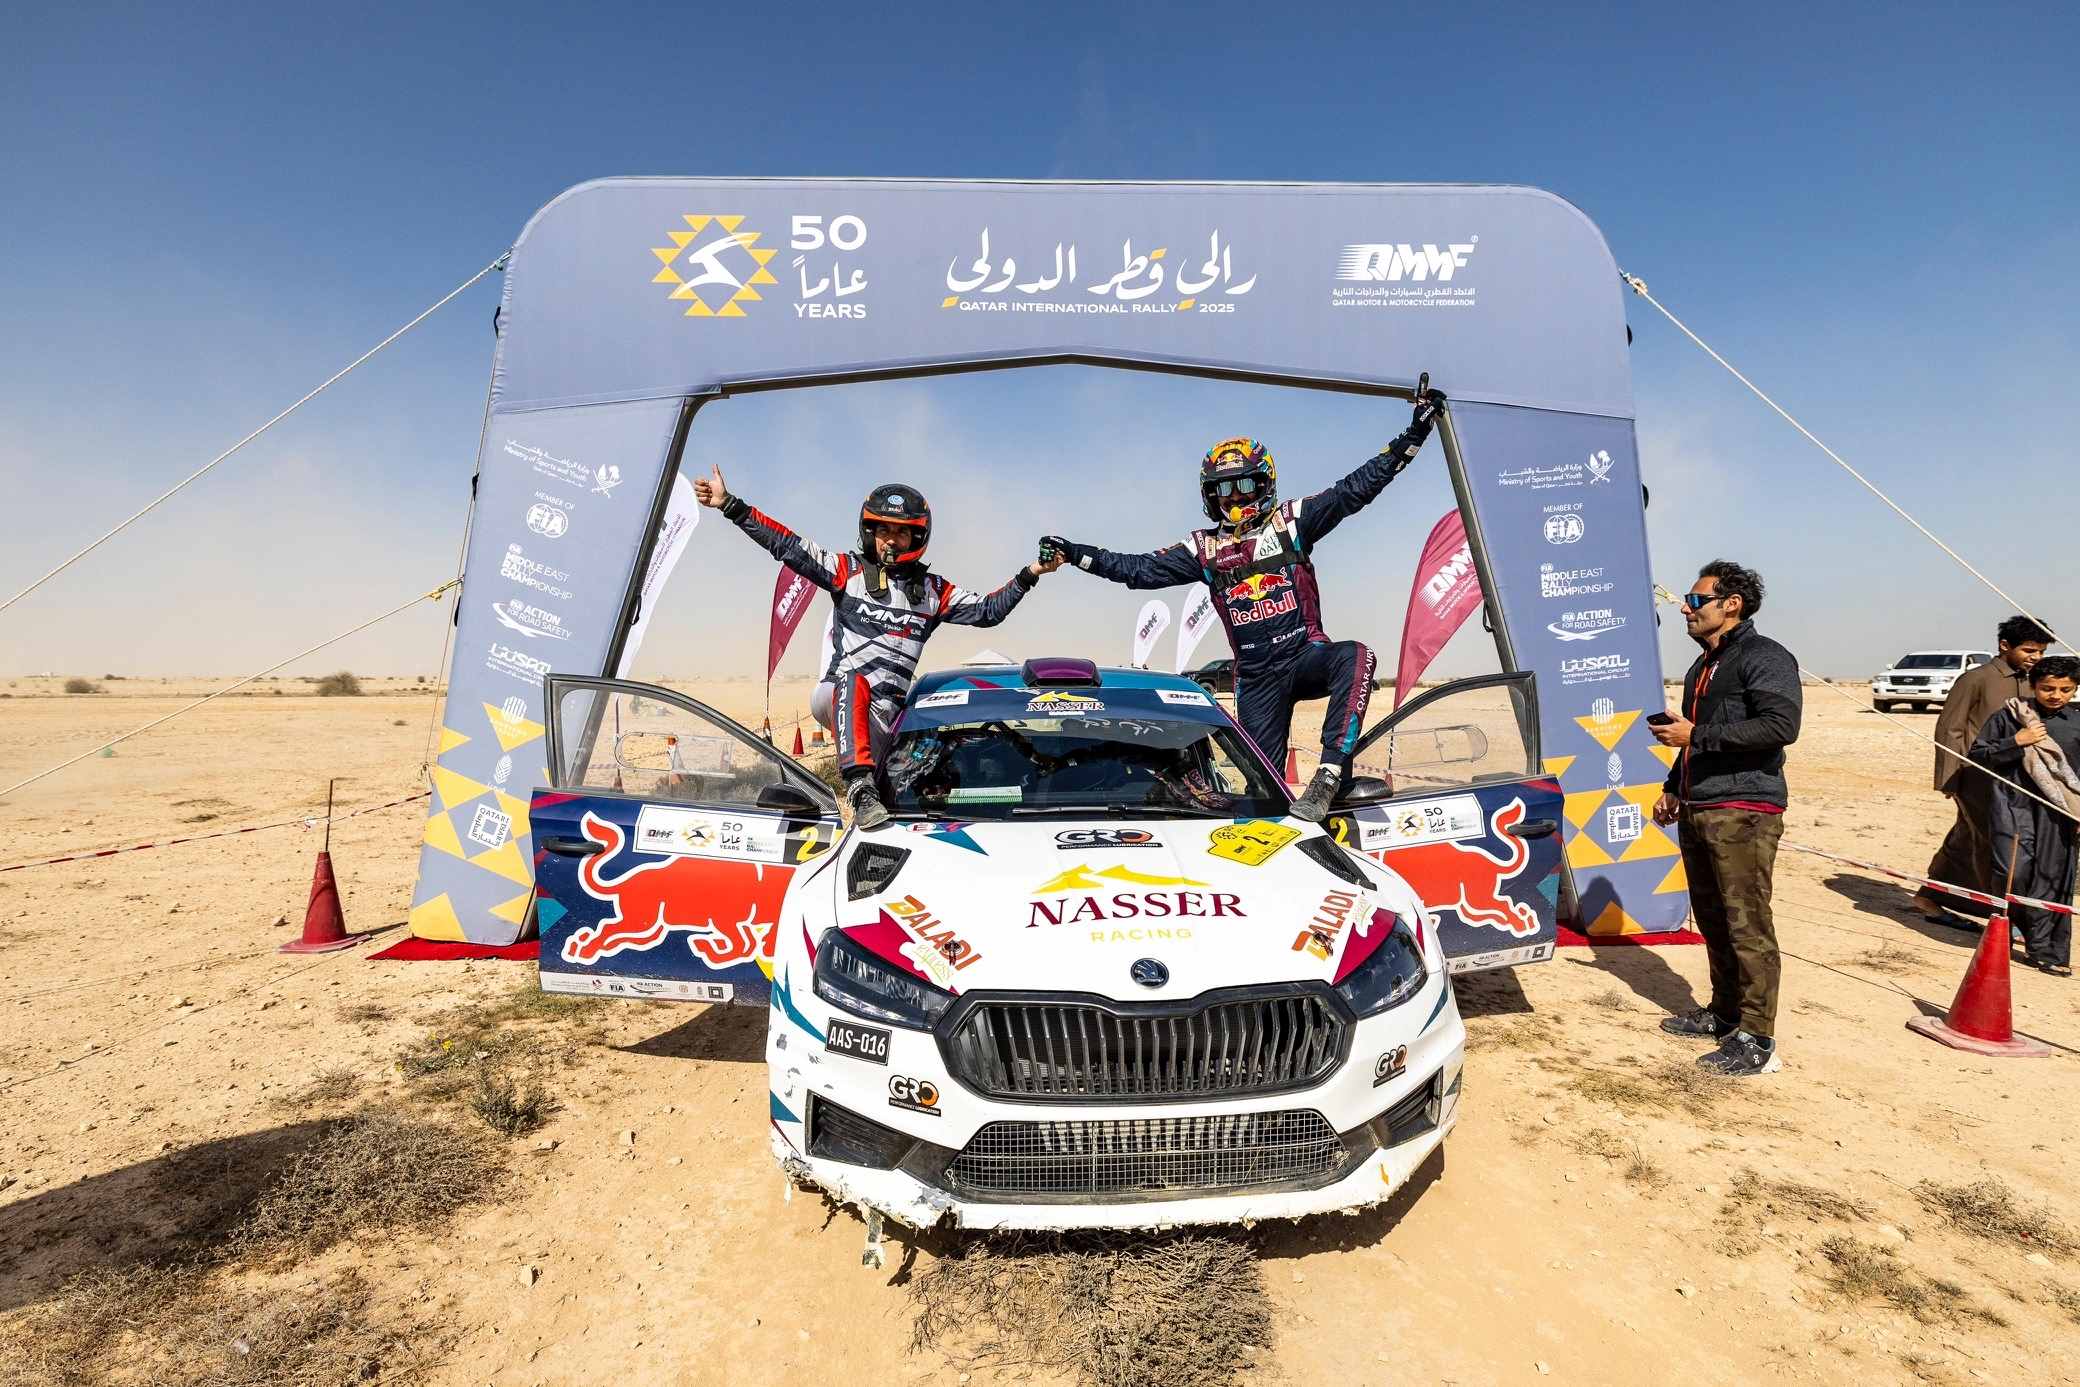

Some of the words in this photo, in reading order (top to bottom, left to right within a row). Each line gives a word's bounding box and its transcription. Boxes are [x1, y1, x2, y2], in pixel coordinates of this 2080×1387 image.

[790, 214, 868, 250] 50
[946, 225, 1077, 293] الدولي
[1087, 238, 1168, 300] قطر
[1176, 228, 1257, 294] رالي
[1333, 243, 1475, 281] QMMF
[793, 303, 867, 319] YEARS
[959, 301, 1008, 311] QATAR
[1011, 302, 1129, 314] INTERNATIONAL
[1132, 303, 1178, 314] RALLY
[1199, 303, 1235, 313] 2025
[1543, 503, 1572, 513] MEMBER
[1573, 502, 1584, 511] OF
[1545, 518, 1581, 540] FIA
[502, 560, 535, 577] RALLY
[544, 566, 570, 584] EAST
[1417, 541, 1474, 609] QMM
[1541, 570, 1578, 581] MIDDLE
[1580, 567, 1604, 578] EAST
[500, 568, 573, 600] CHAMPIONSHIP
[1541, 579, 1572, 590] RALLY
[1541, 582, 1614, 598] CHAMPIONSHIP
[523, 605, 561, 625] ACTION
[1229, 601, 1262, 626] Red
[1261, 590, 1298, 619] Bull
[1576, 609, 1612, 621] ACTION
[518, 613, 541, 627] ROAD
[541, 621, 573, 639] SAFETY
[1574, 620, 1596, 630] ROAD
[1597, 616, 1627, 628] SAFETY
[1356, 672, 1371, 712] QATAR
[1025, 701, 1105, 712] NASSER
[1424, 806, 1443, 817] 50
[720, 821, 743, 832] 50
[1054, 829, 1154, 844] GRO
[1328, 816, 1351, 848] 2
[796, 826, 819, 861] 2
[1243, 835, 1271, 846] 2
[1025, 892, 1248, 928] NASSER
[1091, 928, 1193, 943] RACING
[828, 1025, 885, 1057] AAS-016
[1375, 1044, 1407, 1079] GRO
[888, 1074, 940, 1106] GRO
